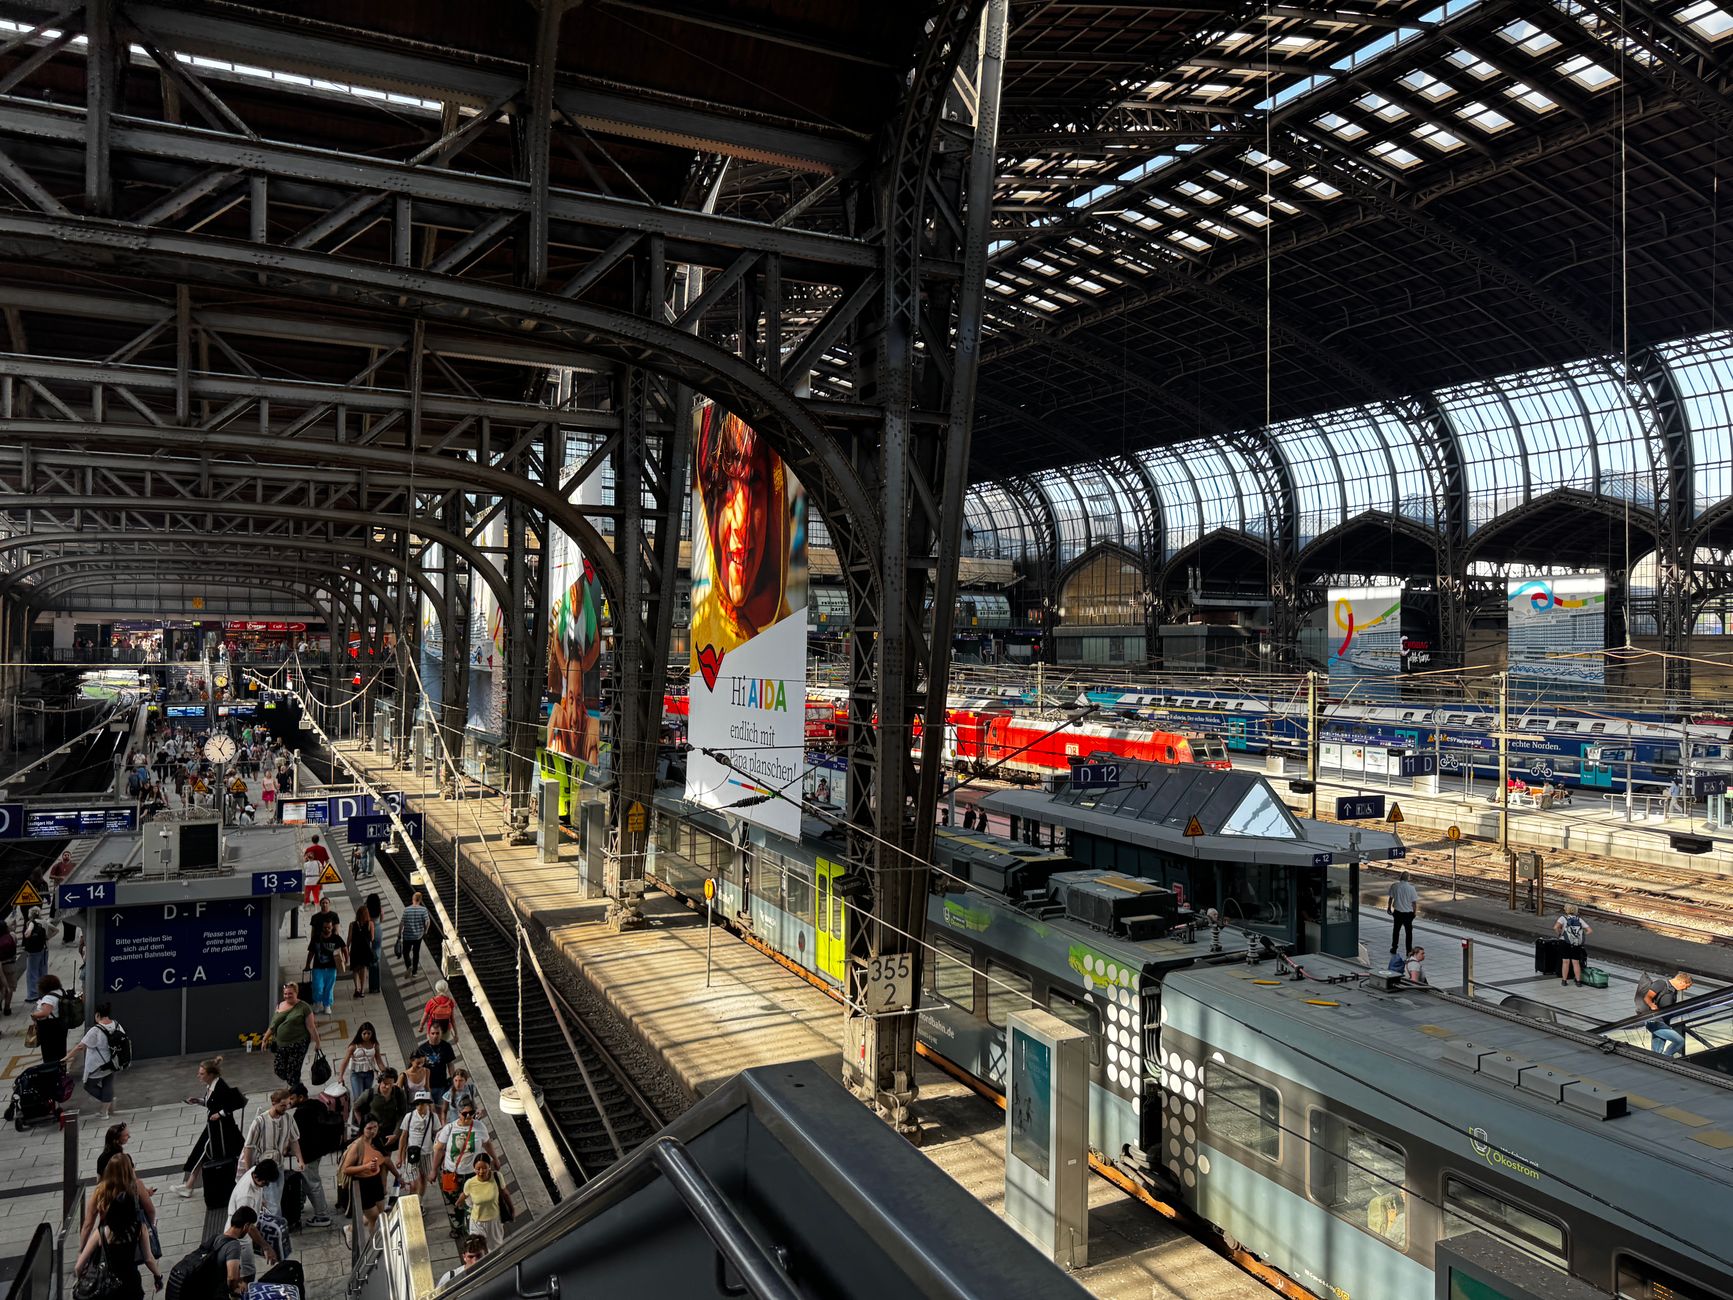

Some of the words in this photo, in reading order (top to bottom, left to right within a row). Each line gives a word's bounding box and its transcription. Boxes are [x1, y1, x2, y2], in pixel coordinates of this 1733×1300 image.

[748, 678, 787, 712] AIDA
[730, 720, 758, 743] endlich
[760, 726, 775, 747] mit
[1511, 740, 1531, 749] echte
[1532, 741, 1561, 750] Norden.
[749, 752, 797, 782] planschen!
[1404, 758, 1415, 772] 11
[1424, 757, 1433, 772] D
[1081, 767, 1091, 782] D
[1101, 766, 1117, 782] 12
[338, 797, 358, 822] D
[1322, 854, 1329, 862] 12
[261, 874, 278, 888] 13
[87, 885, 105, 900] 14
[164, 904, 177, 920] D
[196, 902, 207, 918] F
[221, 944, 248, 953] platform
[225, 937, 245, 945] length
[110, 953, 143, 962] gesamten
[144, 949, 177, 958] Bahnsteig
[163, 967, 176, 984] C
[193, 965, 207, 981] A
[870, 956, 910, 982] 355
[883, 982, 897, 1006] 2
[1493, 1151, 1540, 1180] Ökostrom
